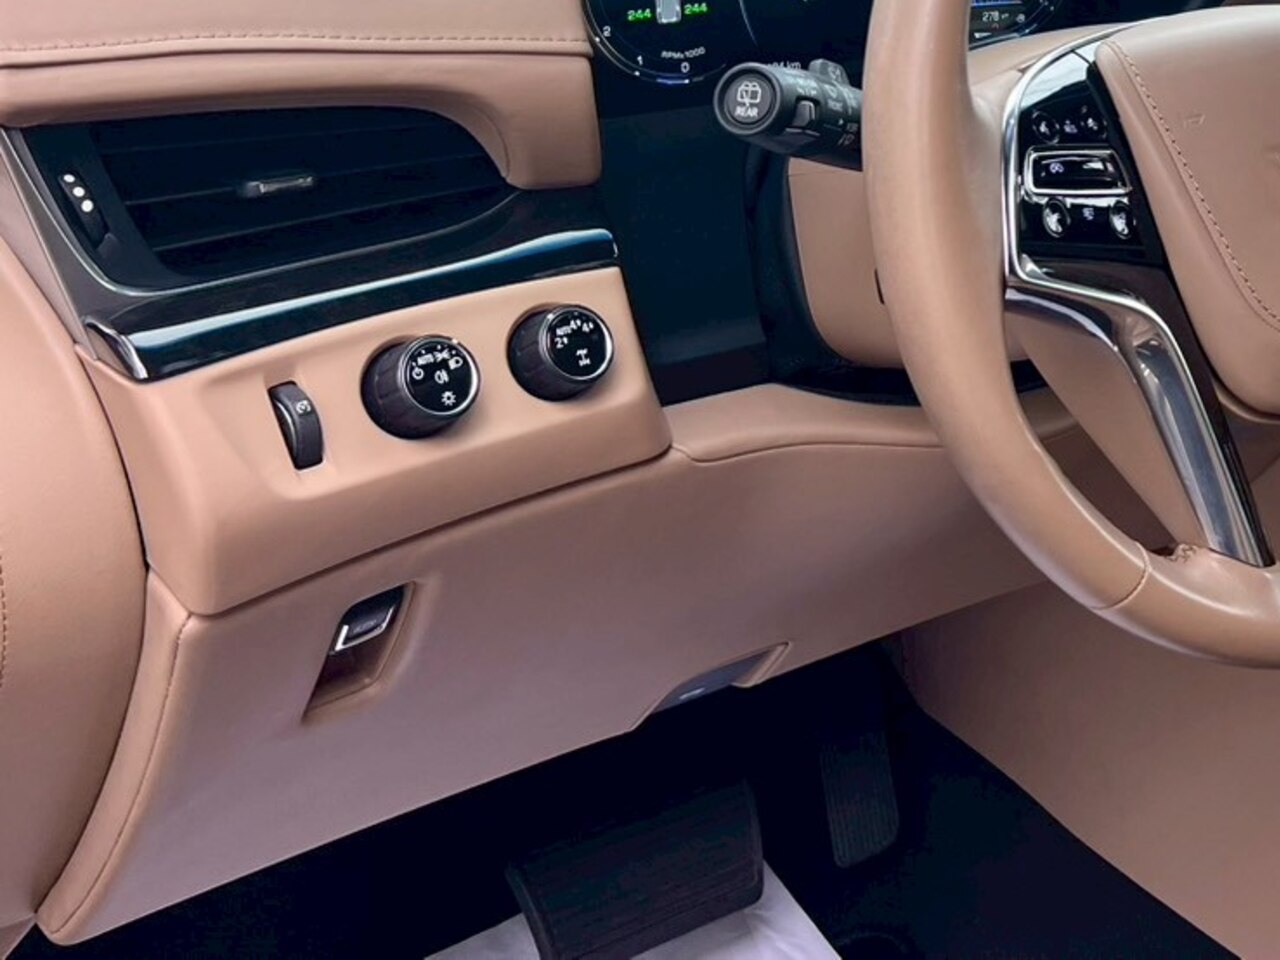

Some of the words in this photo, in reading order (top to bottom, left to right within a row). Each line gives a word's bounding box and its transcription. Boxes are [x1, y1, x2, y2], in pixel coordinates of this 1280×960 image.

[684, 2, 708, 16] 244
[627, 8, 652, 22] 244
[602, 26, 612, 37] 2
[636, 56, 644, 66] 1
[681, 62, 690, 72] 0
[734, 106, 759, 118] REAR
